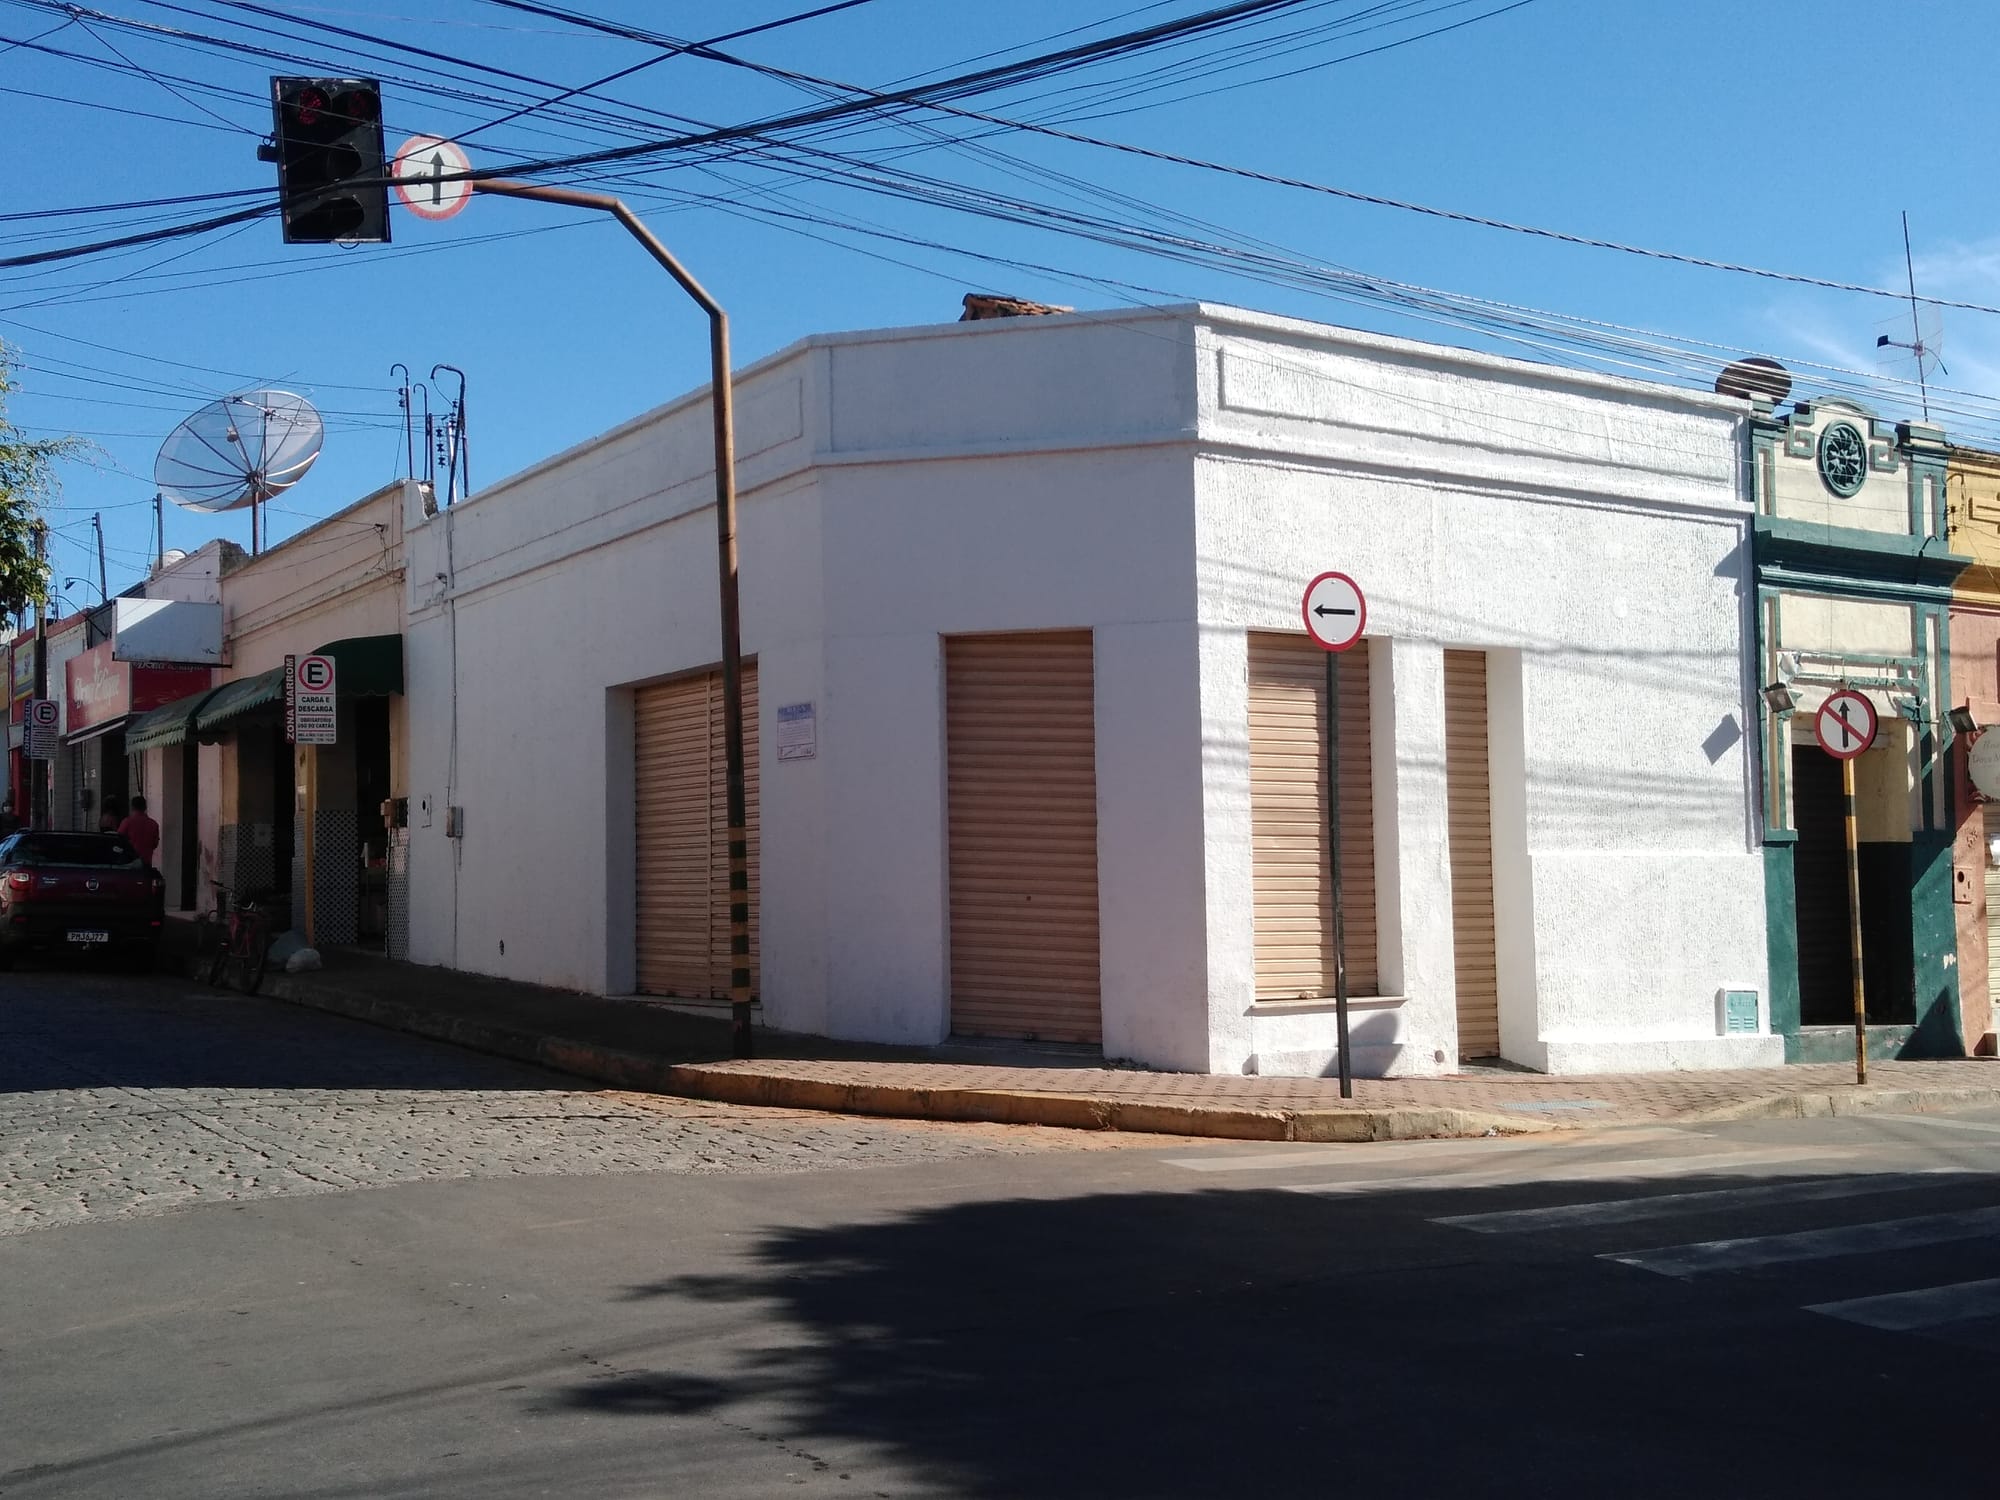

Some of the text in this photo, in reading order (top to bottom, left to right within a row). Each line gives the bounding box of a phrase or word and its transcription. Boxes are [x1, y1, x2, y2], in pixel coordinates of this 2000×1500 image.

[307, 663, 323, 684] E
[286, 658, 294, 740] ZONA MARROM
[40, 706, 51, 720] E
[298, 705, 334, 713] DESCARGA
